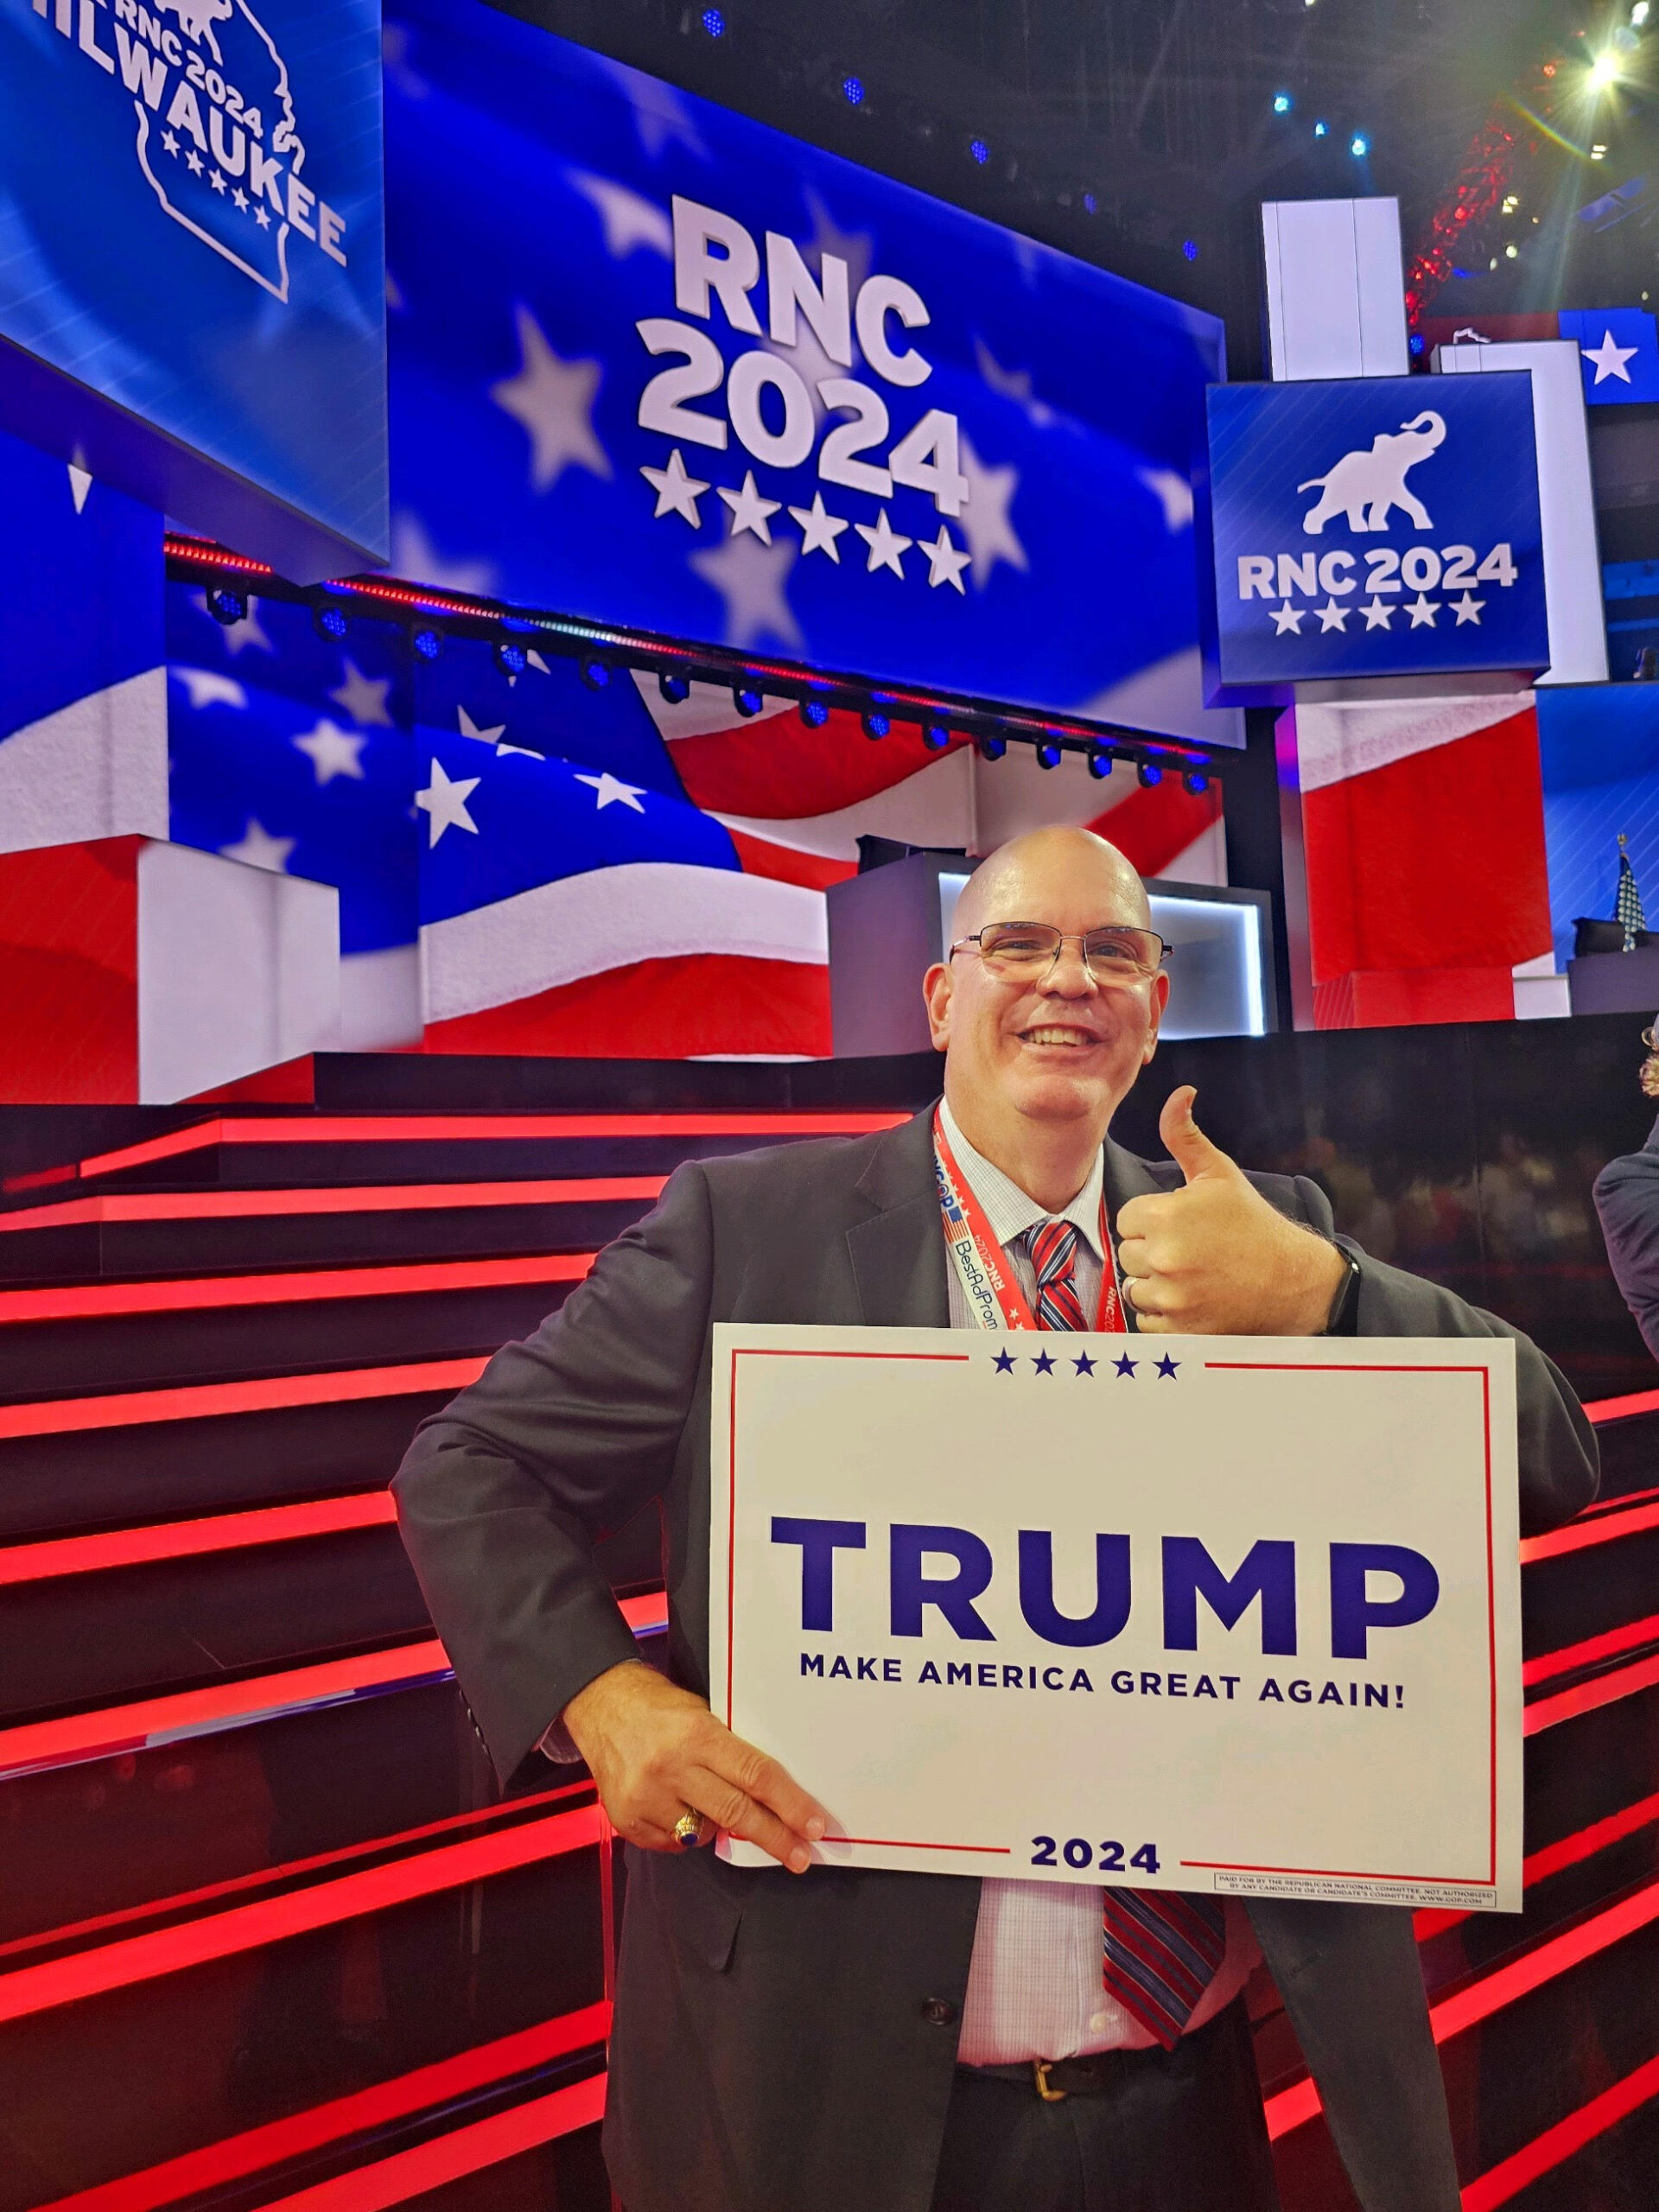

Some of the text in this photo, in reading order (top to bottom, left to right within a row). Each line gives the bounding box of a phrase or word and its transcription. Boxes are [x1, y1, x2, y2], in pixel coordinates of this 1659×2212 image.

[32, 0, 347, 268] ILWAUKEE
[115, 0, 263, 139] RNC 2024
[671, 193, 933, 389] RNC
[634, 317, 971, 518] 2024
[1237, 543, 1518, 601] RNC 2024
[770, 1516, 1440, 1660] TRUMP
[800, 1652, 1405, 1709] MAKE AMERICA GREAT AGAIN!
[1030, 1835, 1160, 1874] 2024
